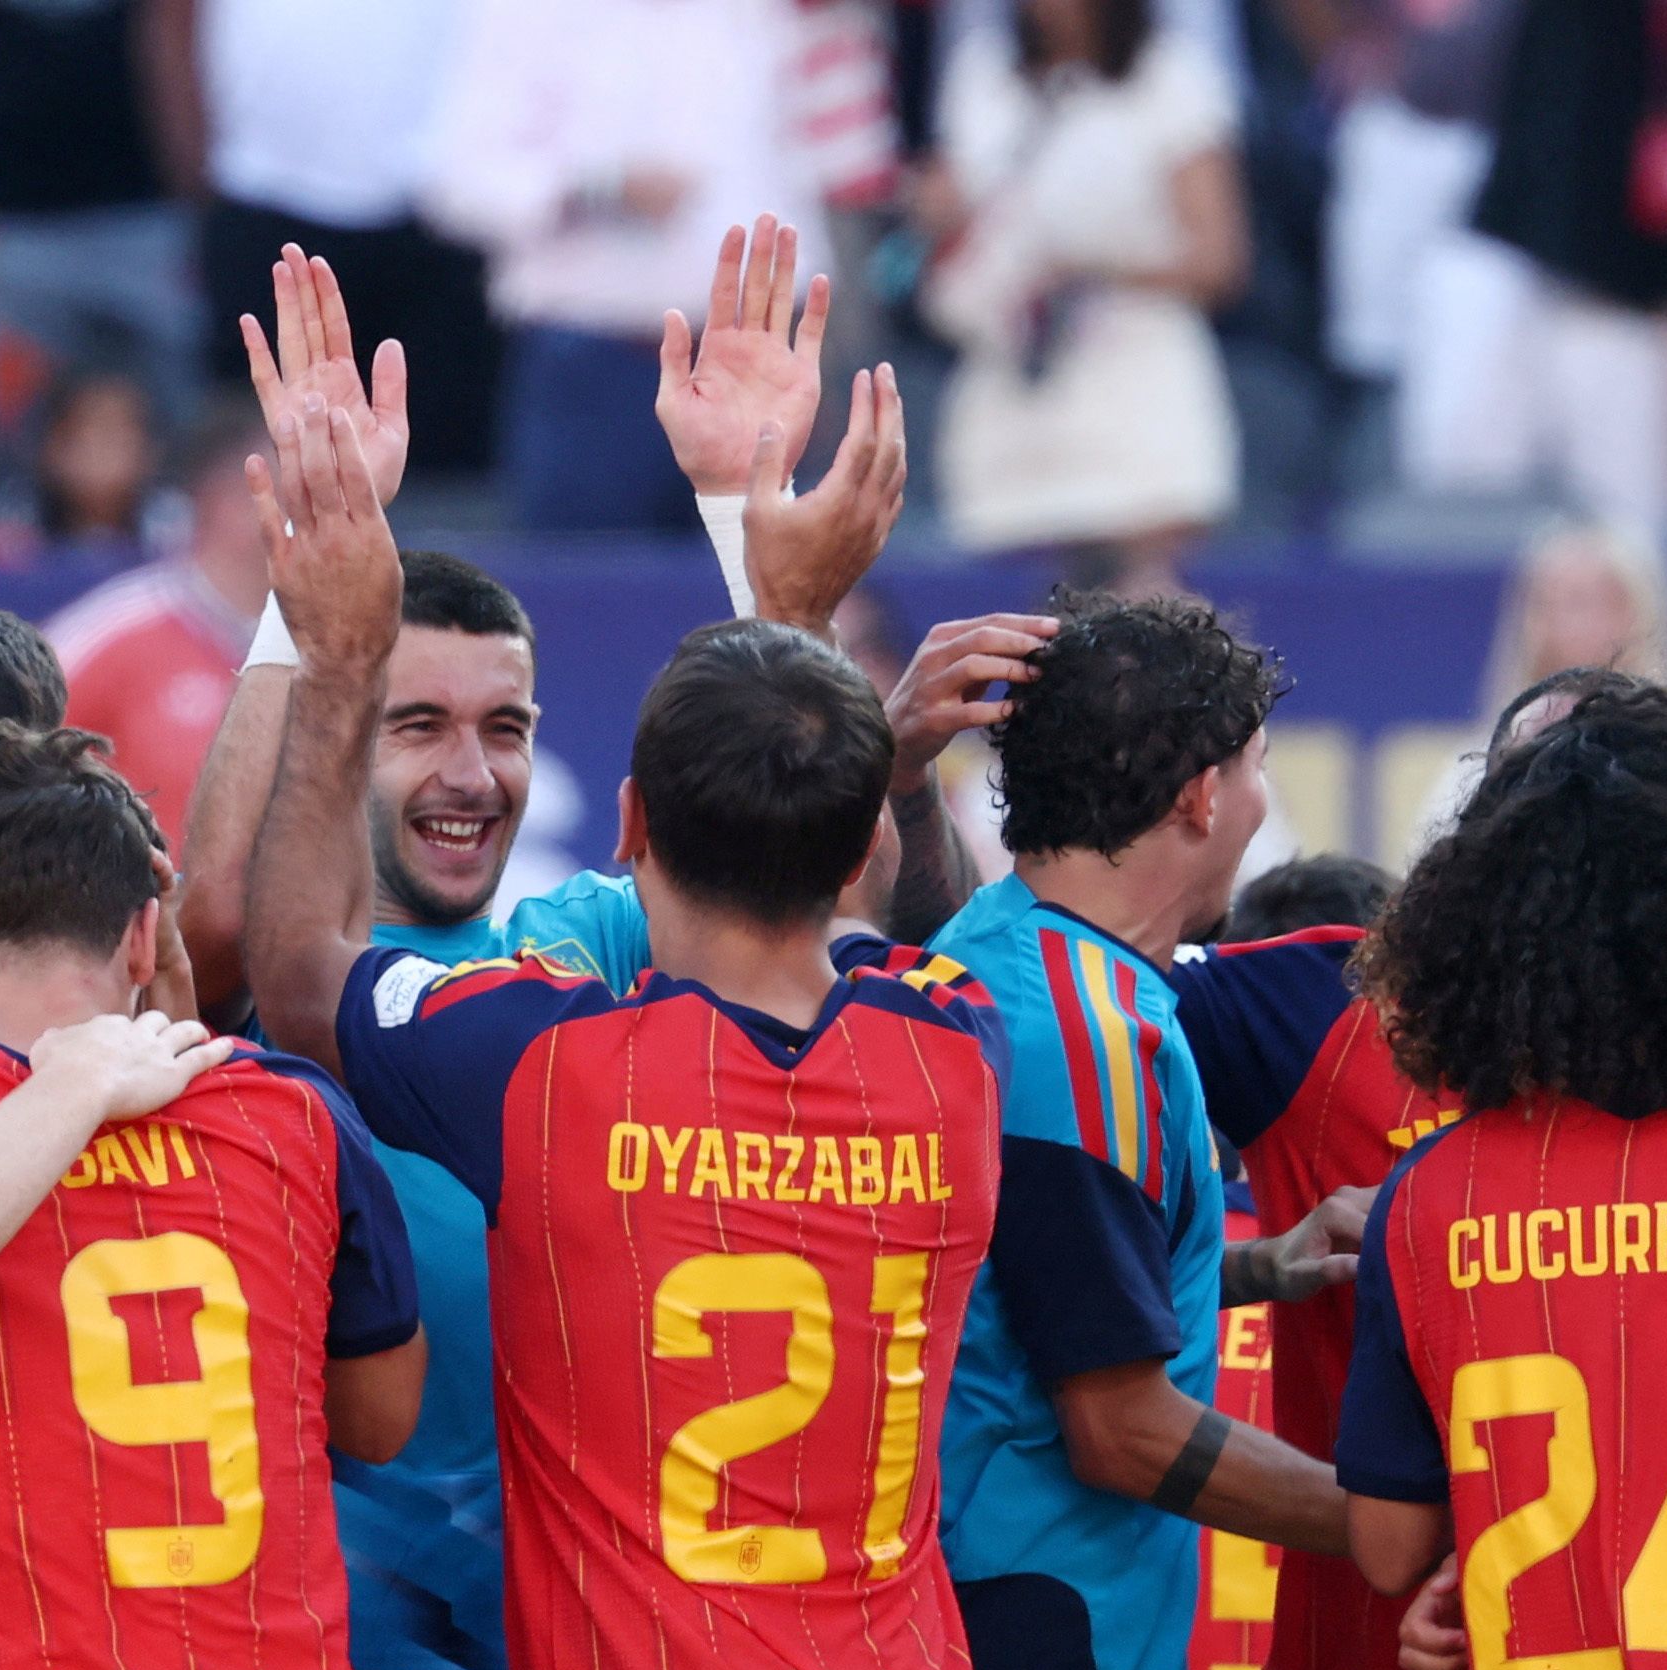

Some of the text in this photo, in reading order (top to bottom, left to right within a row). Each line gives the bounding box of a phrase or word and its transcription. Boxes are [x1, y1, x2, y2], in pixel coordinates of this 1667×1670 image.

[608, 1122, 953, 1205] OYARZABAL
[61, 1231, 264, 1589] 9
[653, 1251, 928, 1584] 21
